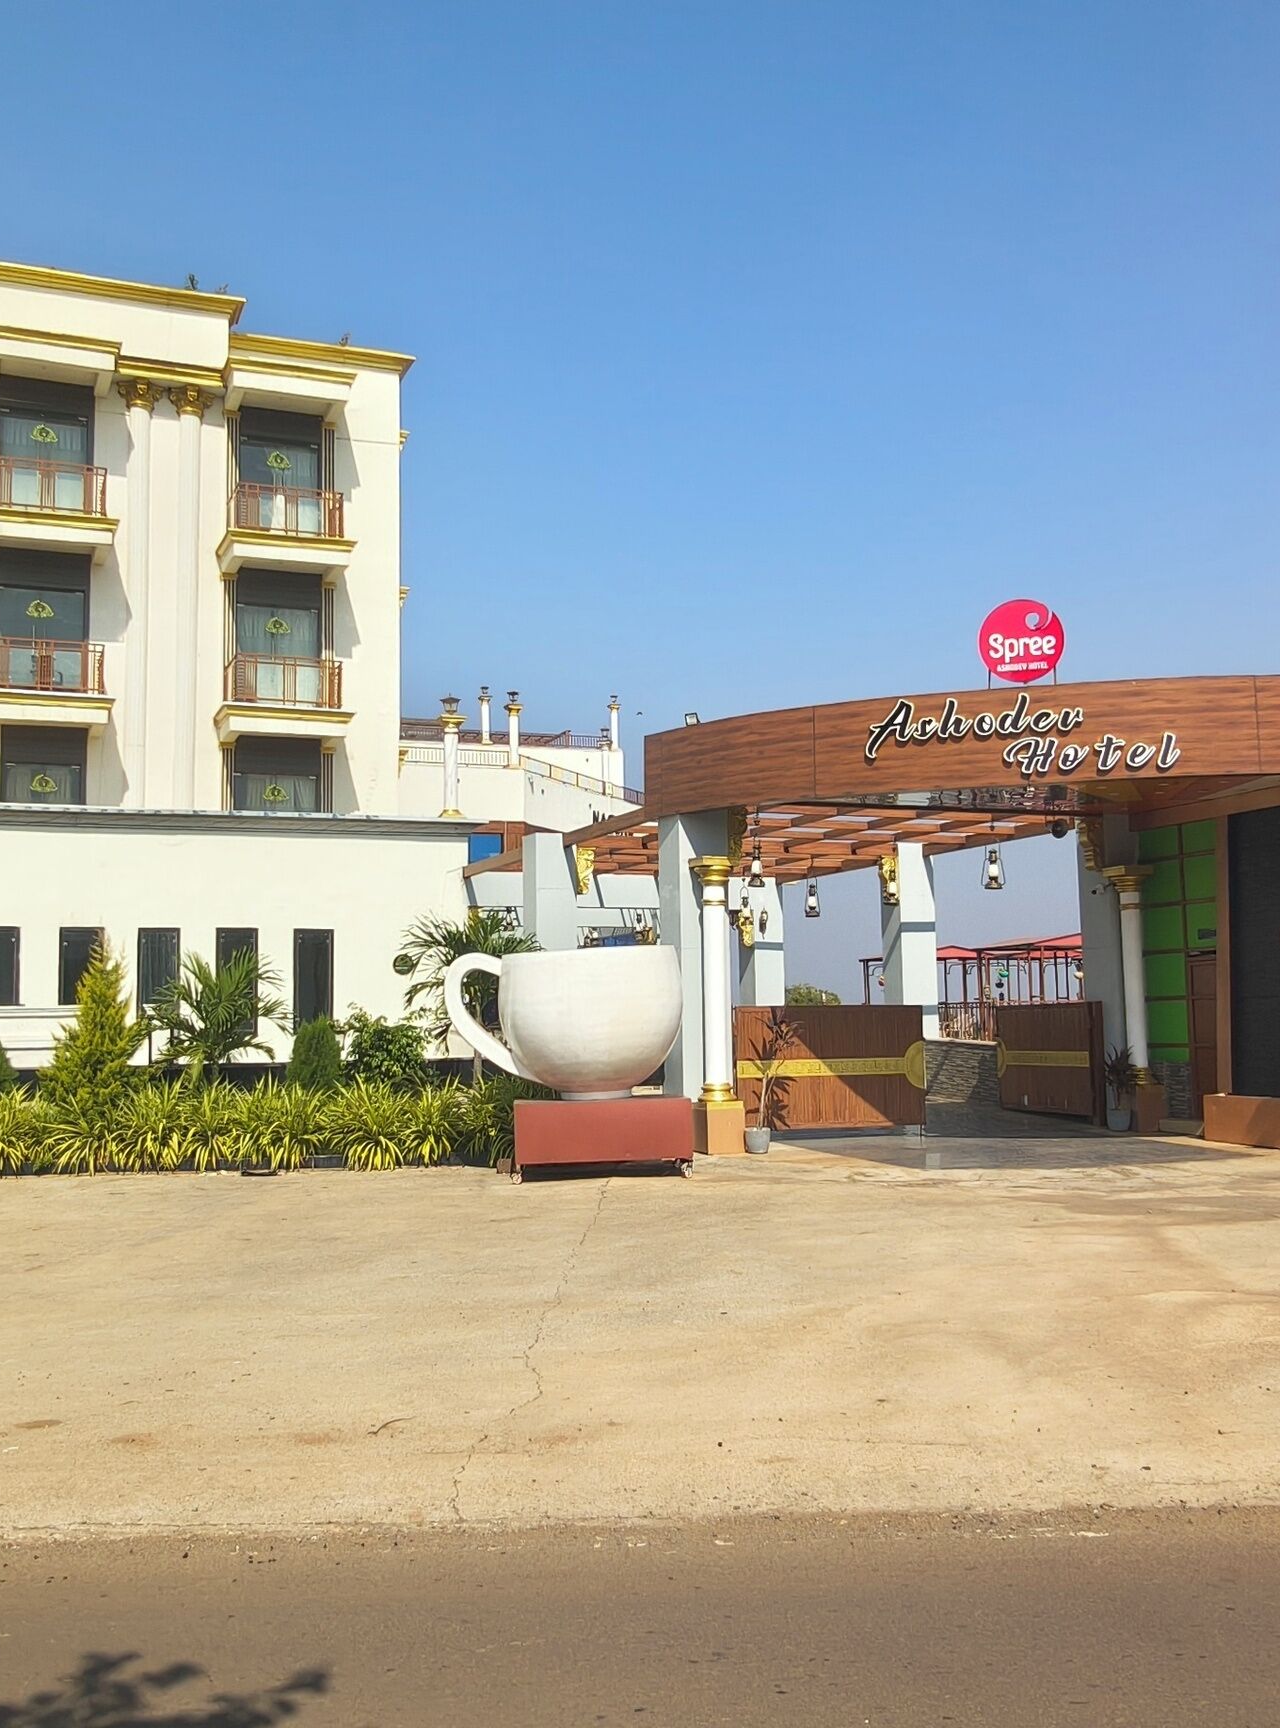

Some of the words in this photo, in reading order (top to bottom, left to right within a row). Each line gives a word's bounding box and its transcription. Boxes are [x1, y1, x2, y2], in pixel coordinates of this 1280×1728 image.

[988, 633, 1056, 663] Spree
[865, 692, 1083, 759] Ashodev
[1003, 731, 1180, 774] Hotel
